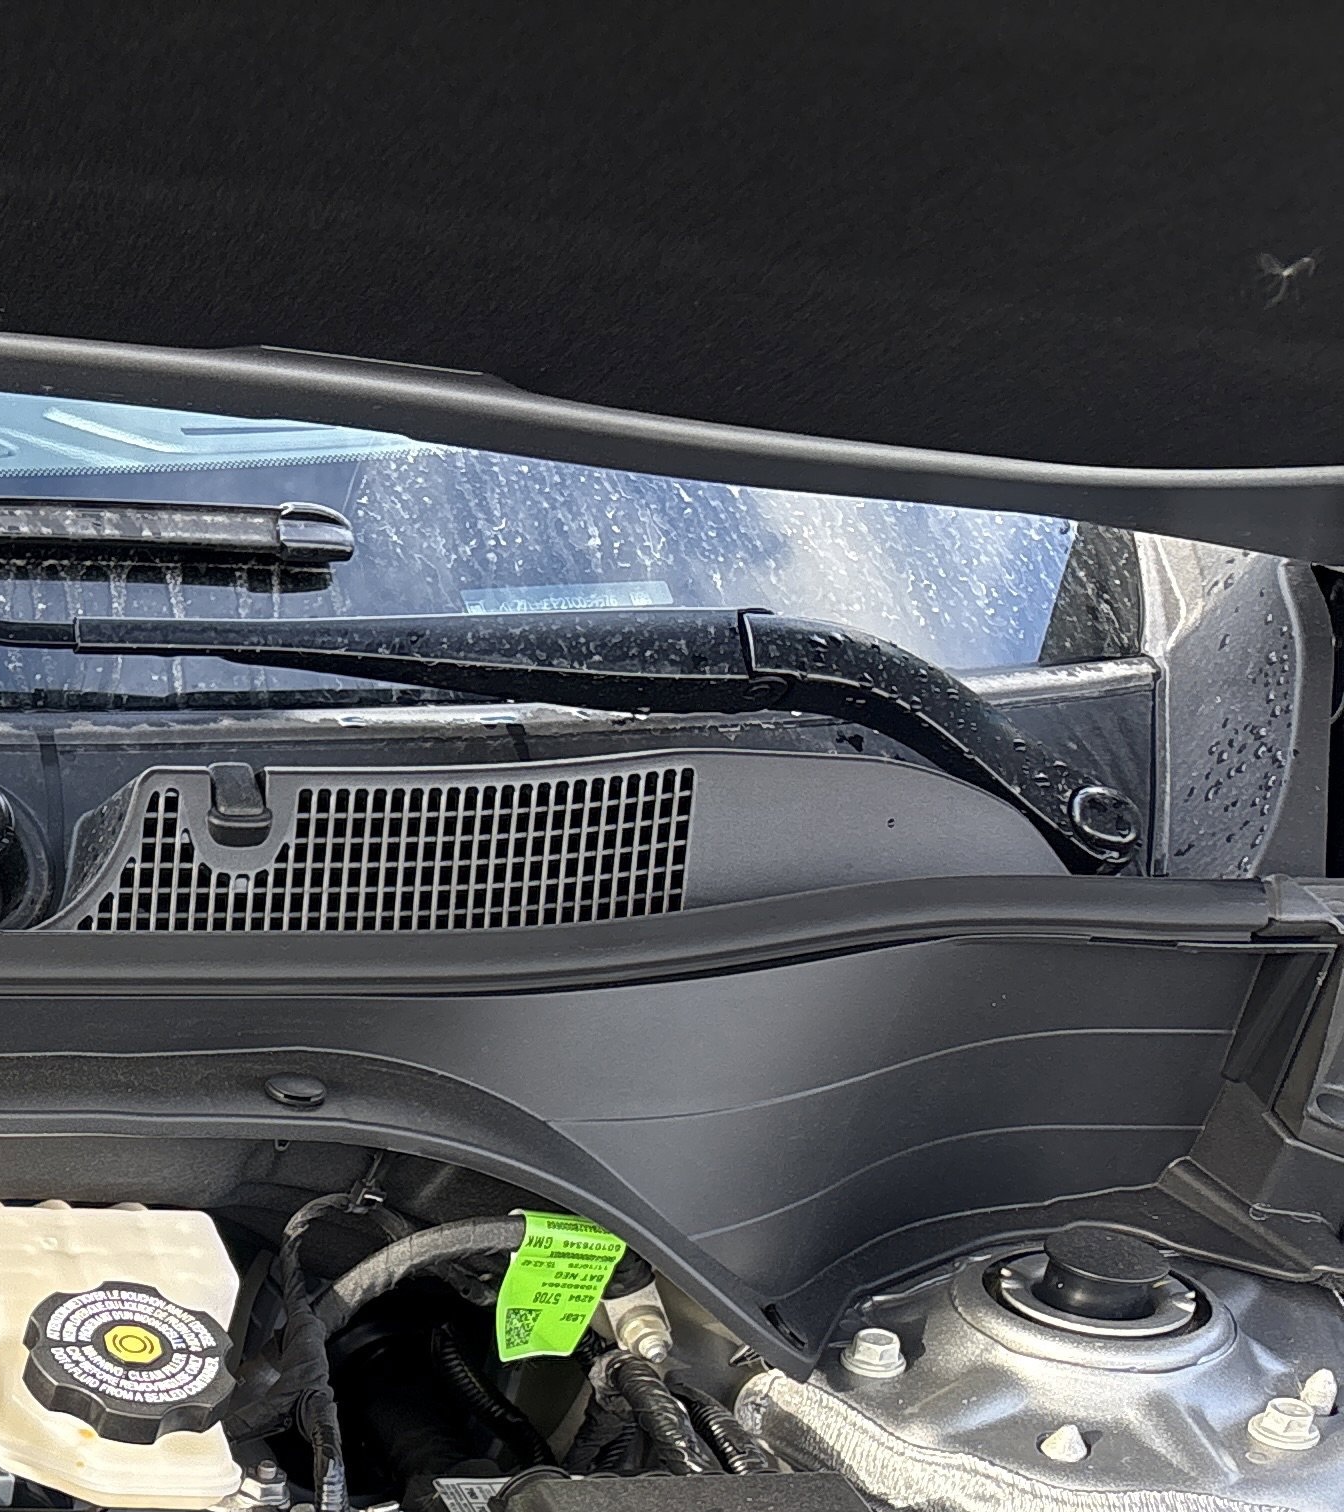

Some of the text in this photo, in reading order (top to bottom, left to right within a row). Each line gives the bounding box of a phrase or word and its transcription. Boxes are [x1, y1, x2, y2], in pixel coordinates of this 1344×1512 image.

[580, 1273, 604, 1283] BAT
[559, 1313, 587, 1325] Lear
[65, 1365, 101, 1389] FLUID
[97, 1382, 133, 1401] FROM
[133, 1391, 144, 1402] A
[143, 1387, 189, 1402] SEALED
